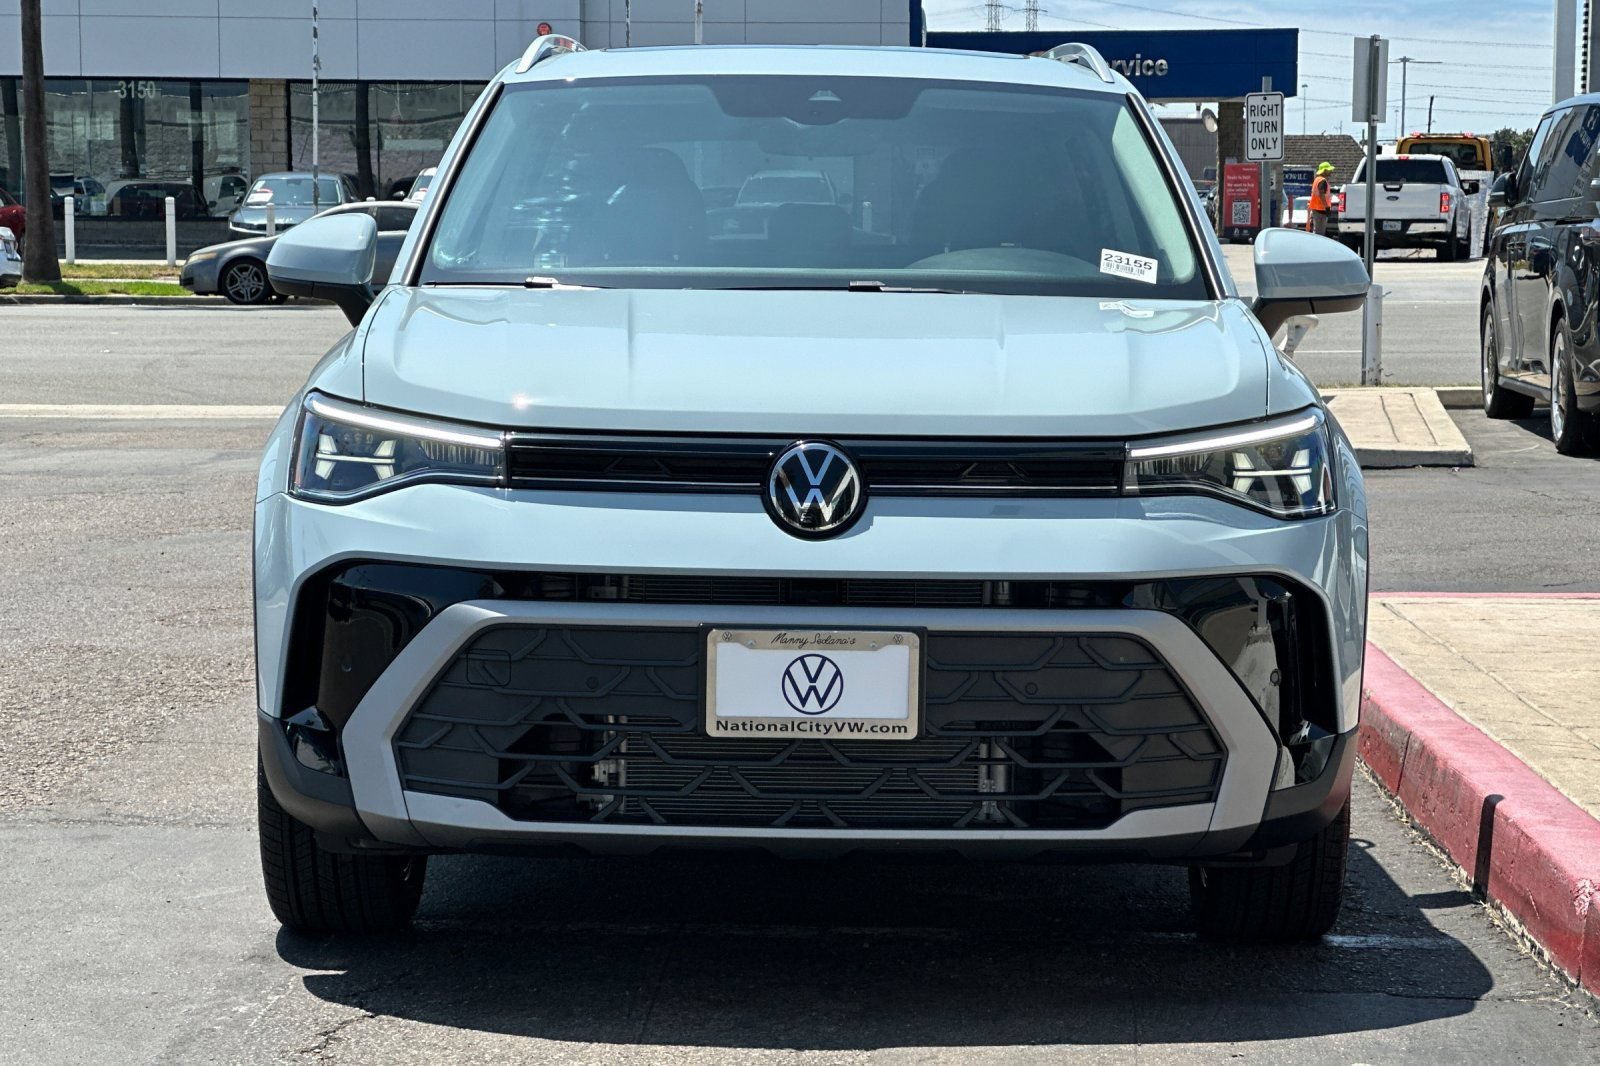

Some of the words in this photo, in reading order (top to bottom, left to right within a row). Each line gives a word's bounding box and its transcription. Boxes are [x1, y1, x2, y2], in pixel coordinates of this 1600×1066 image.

[1107, 54, 1168, 76] rvice
[118, 80, 156, 99] 3150
[1250, 103, 1280, 117] RIGHT
[1251, 121, 1278, 133] TURN
[1251, 137, 1278, 150] ONLY
[1103, 253, 1153, 270] 23155
[770, 632, 808, 649] Manny
[715, 720, 908, 735] NationalCityVW.com
